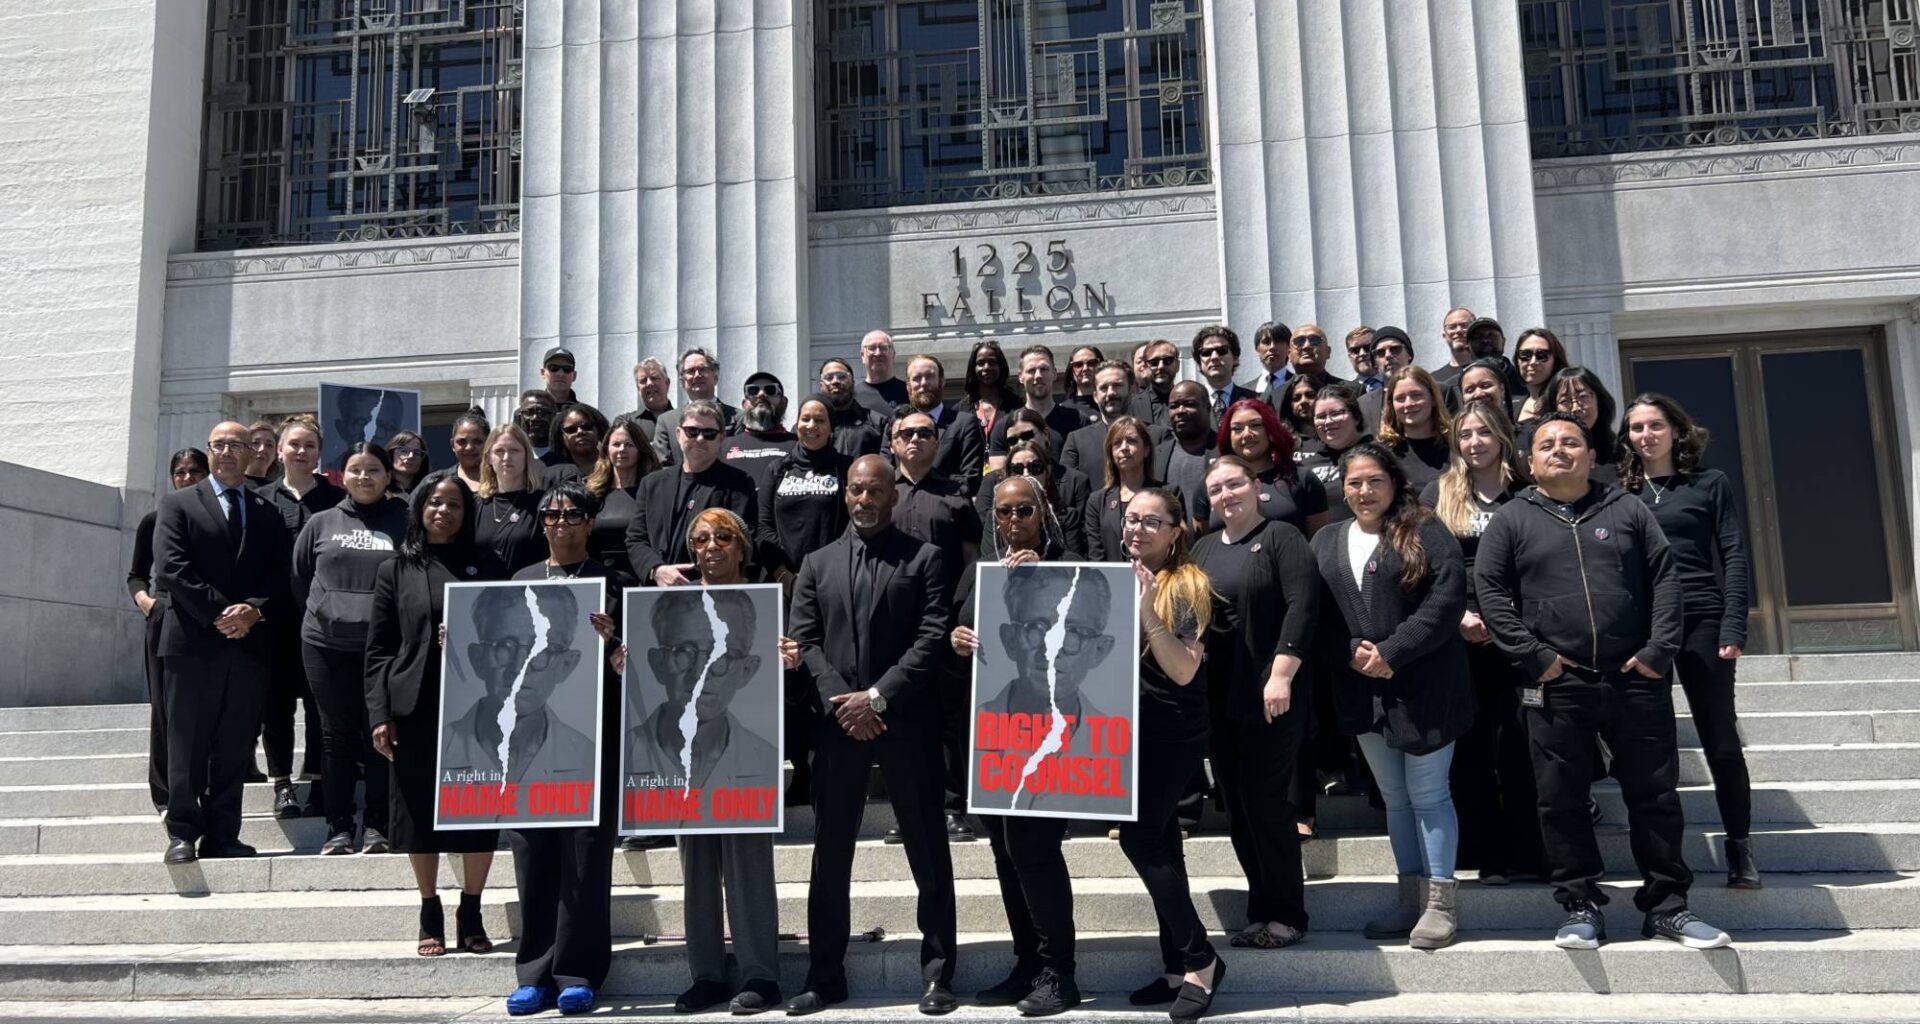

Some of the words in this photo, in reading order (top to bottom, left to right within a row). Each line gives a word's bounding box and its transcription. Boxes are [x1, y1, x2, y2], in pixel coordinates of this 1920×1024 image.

[952, 239, 1070, 278] 1225
[920, 282, 1109, 320] FALLON
[332, 533, 373, 544] NORTH
[341, 540, 372, 550] FACE
[352, 529, 371, 538] THE
[1085, 715, 1131, 756] TO
[442, 770, 453, 782] A
[456, 769, 486, 784] right
[490, 769, 501, 781] in
[626, 775, 636, 787] A
[640, 774, 669, 790] right
[673, 774, 685, 787] in
[978, 752, 1127, 797] COUNSEL
[440, 783, 519, 817] NAME
[527, 780, 593, 816] ONLY
[624, 787, 704, 823] NAME
[711, 784, 777, 822] ONLY
